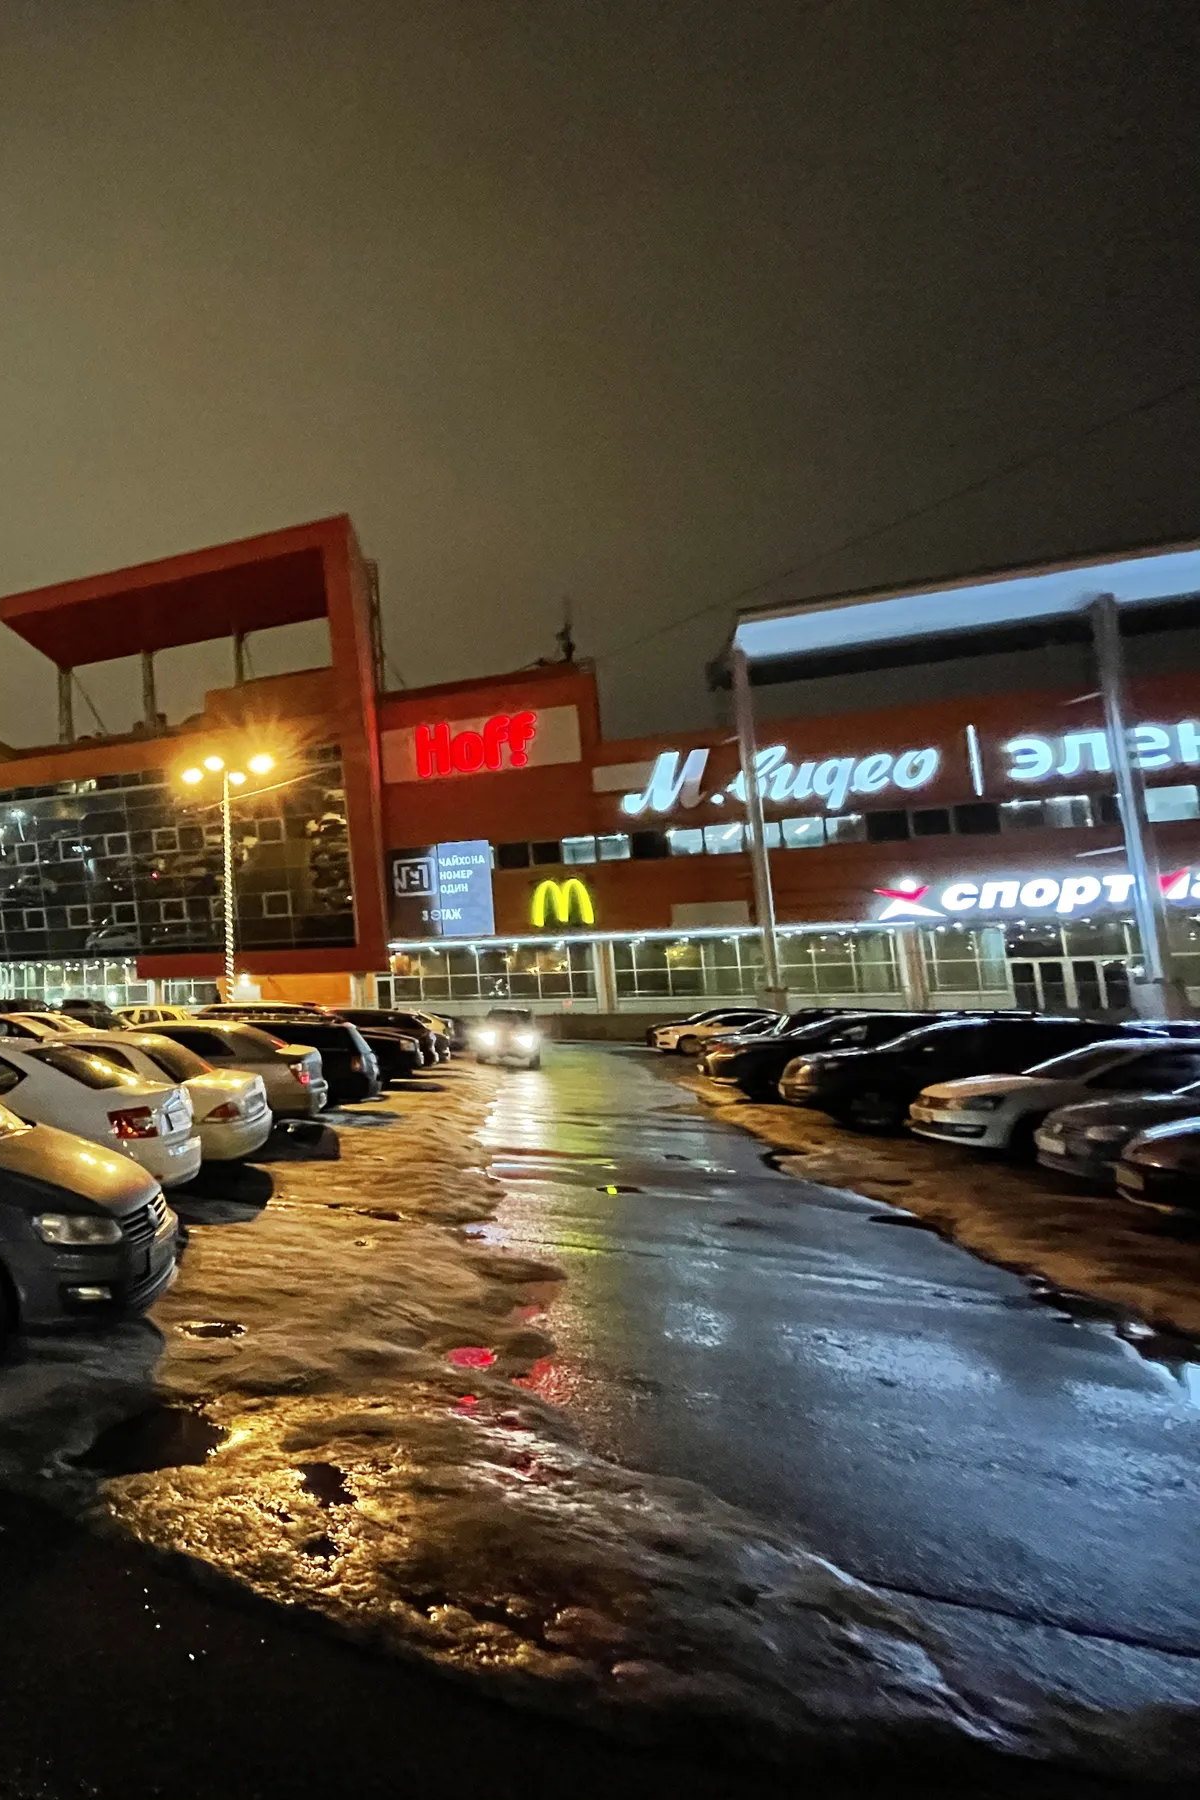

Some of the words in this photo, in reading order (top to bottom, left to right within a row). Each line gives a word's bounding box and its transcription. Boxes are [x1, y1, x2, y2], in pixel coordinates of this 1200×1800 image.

[415, 711, 538, 778] Hoff
[438, 855, 485, 868] ЧАЙХОНА
[440, 870, 473, 881] НОМЕР
[440, 882, 469, 894] ОДИН
[421, 911, 429, 922] 3
[430, 908, 462, 922] ЭТАЖ
